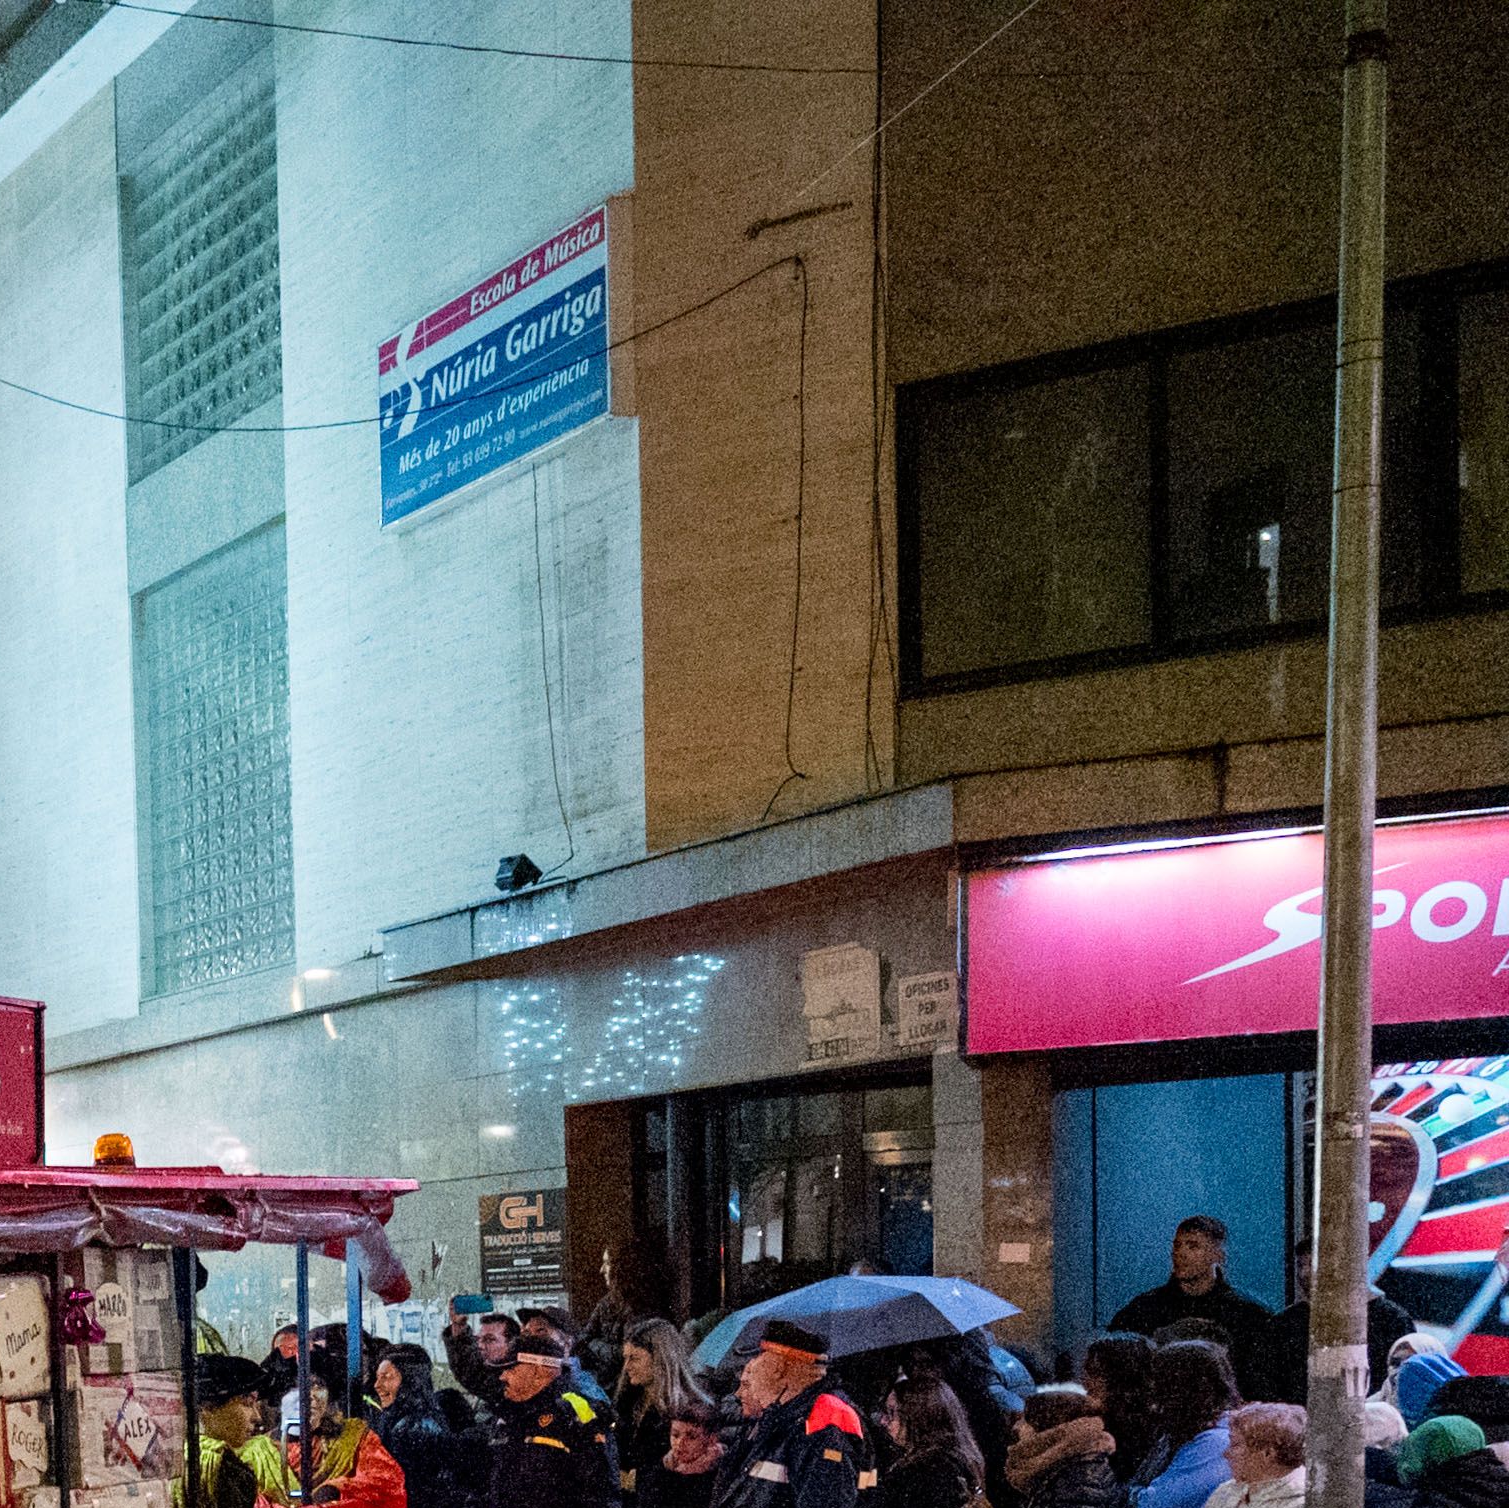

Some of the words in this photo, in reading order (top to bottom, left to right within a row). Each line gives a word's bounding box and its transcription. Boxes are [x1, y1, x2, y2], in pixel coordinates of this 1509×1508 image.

[469, 274, 517, 317] Escola
[520, 256, 541, 286] de
[543, 220, 602, 269] Música
[430, 343, 498, 407] Núria
[505, 283, 604, 363] Garriga
[398, 448, 423, 475] Més
[425, 436, 441, 458] de
[443, 426, 460, 450] 20
[462, 413, 494, 439] anys
[496, 356, 590, 423] d'experiència
[461, 452, 474, 471] 93
[491, 436, 504, 454] 72
[503, 427, 517, 448] 90
[499, 1193, 545, 1229] GH
[123, 1416, 152, 1442] ALEX
